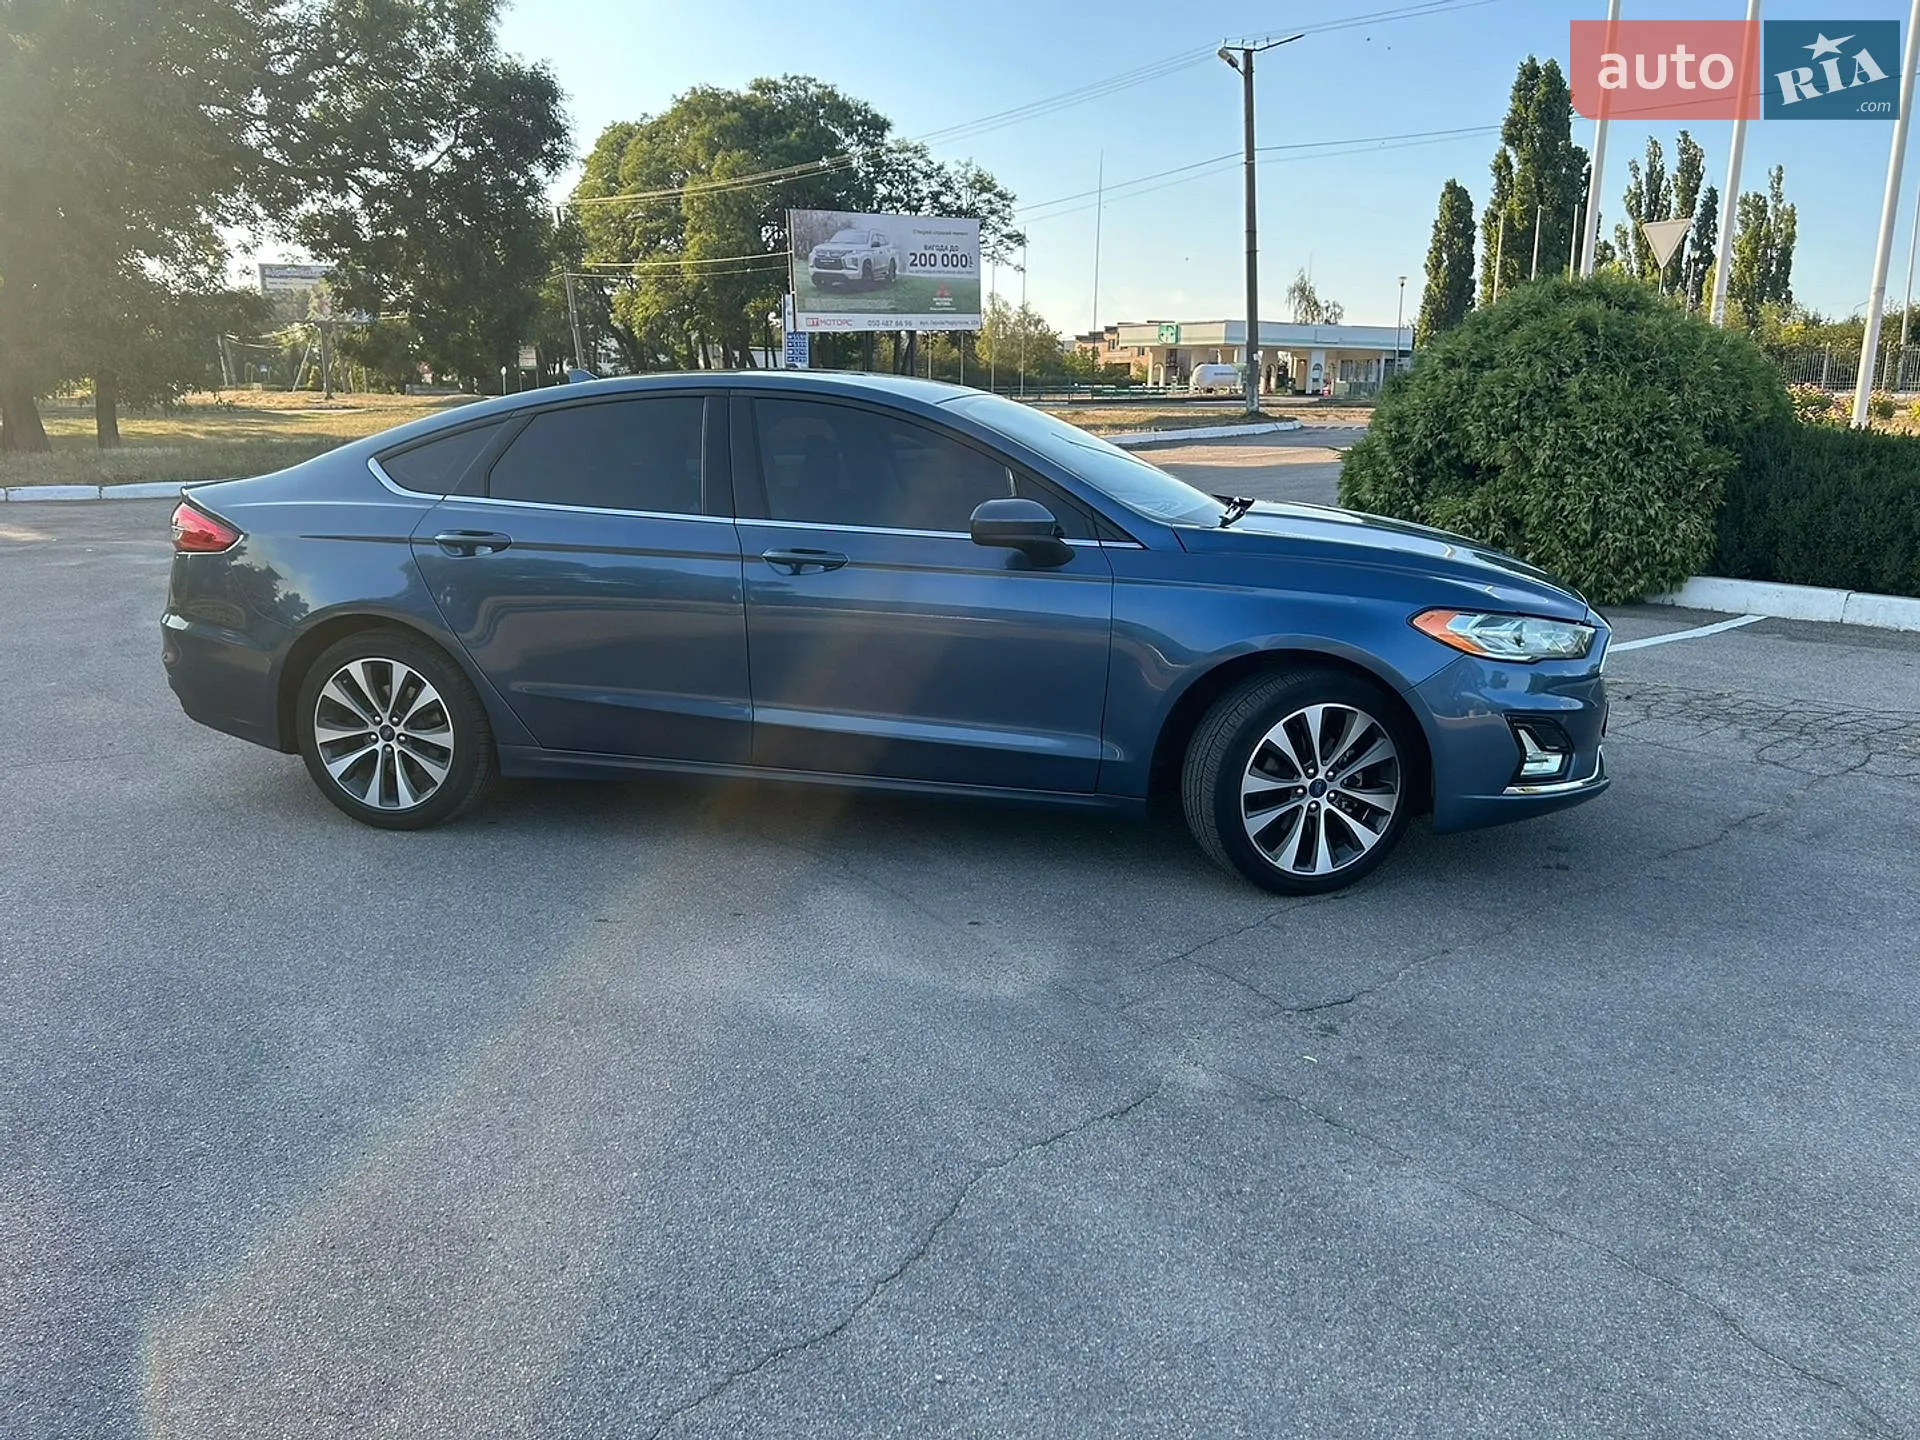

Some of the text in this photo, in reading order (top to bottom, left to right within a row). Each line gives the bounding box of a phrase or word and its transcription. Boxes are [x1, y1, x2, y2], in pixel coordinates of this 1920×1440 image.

[923, 244, 949, 252] ВИГОДА
[909, 252, 937, 268] 200
[941, 253, 969, 268] 000
